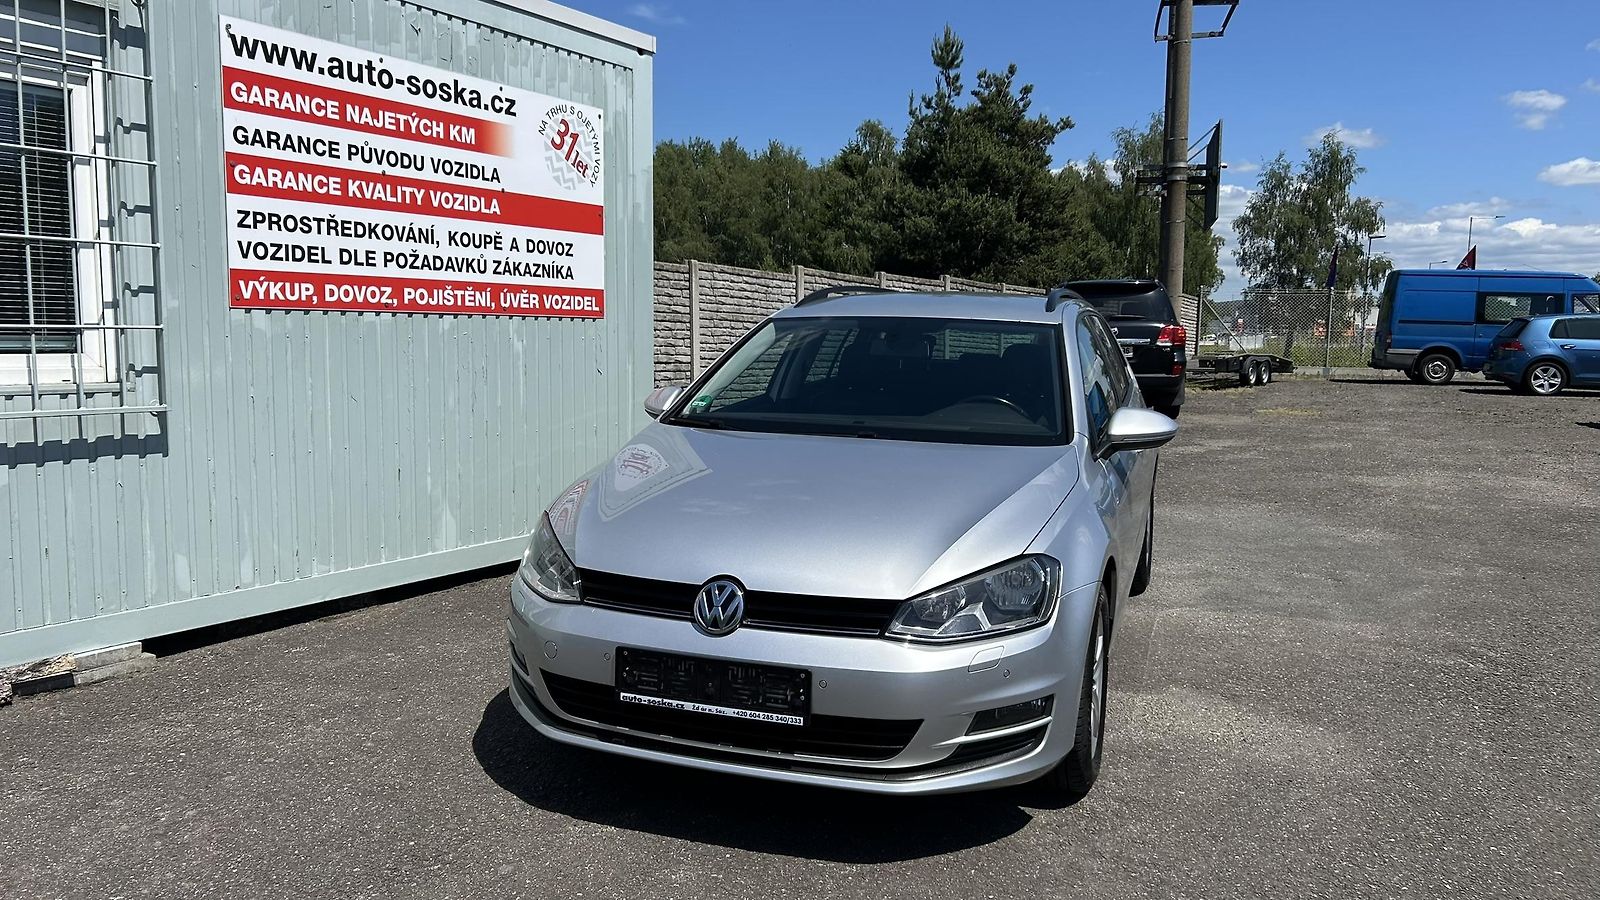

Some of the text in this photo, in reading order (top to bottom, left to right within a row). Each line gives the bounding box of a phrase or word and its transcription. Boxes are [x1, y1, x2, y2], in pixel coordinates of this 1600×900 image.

[230, 33, 517, 117] www.auto-soska.cz
[230, 81, 476, 145] GARANCE NAJETÝCH KM
[232, 125, 501, 184] GARANCE PŮVODU VOZIDLA
[538, 120, 549, 136] NA
[545, 104, 568, 120] TRHU
[569, 105, 576, 116] S
[589, 159, 601, 188] VOZY
[550, 118, 589, 179] 31 let
[233, 164, 501, 215] GARANCE KVALITY VOZIDLA
[236, 209, 574, 257] ZPROSTŘEDKOVÁNÍ, KOUPĚ A DOVOZ
[237, 240, 574, 280] VOZIDEL DLE POŽADAVKŮ ZÁKAZNÍKA
[238, 276, 600, 311] VÝKUP, DOVOZ, POJIŠTĚNÍ, ÚVĚR VOZIDEL
[621, 695, 686, 710] auto-soska.cz
[732, 710, 748, 718] +420
[761, 713, 774, 721] 285
[775, 715, 802, 725] 340/333
